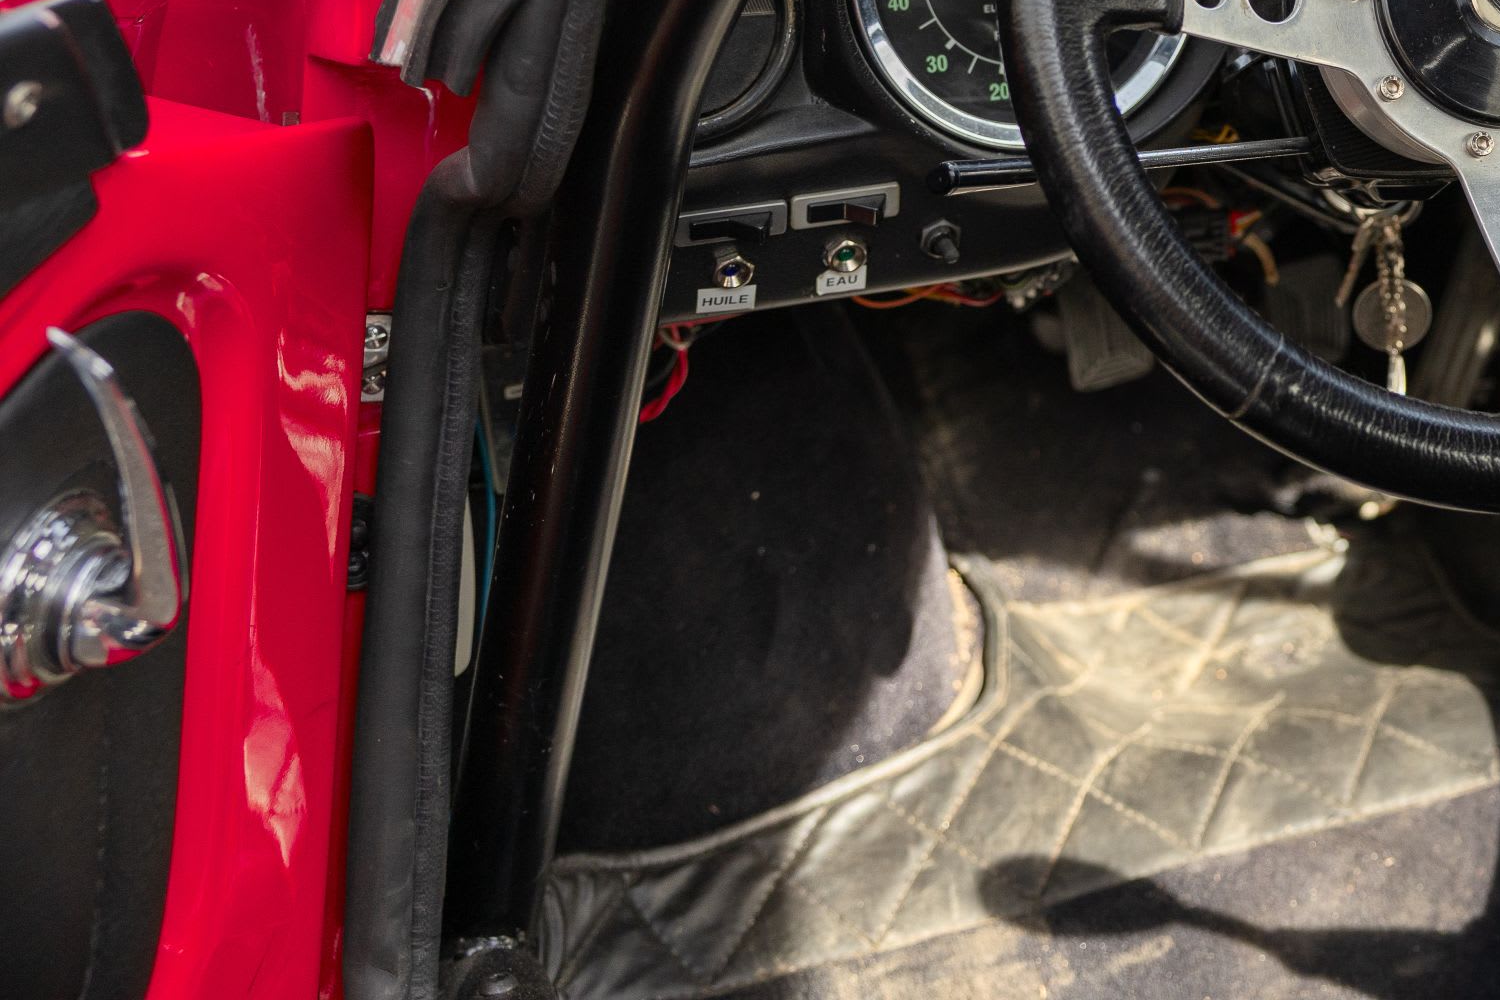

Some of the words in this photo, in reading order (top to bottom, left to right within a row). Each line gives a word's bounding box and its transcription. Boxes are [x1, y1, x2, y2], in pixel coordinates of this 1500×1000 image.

[926, 55, 948, 73] 30
[989, 82, 1009, 101] 20
[826, 275, 858, 287] EAU
[702, 294, 749, 307] HUILE
